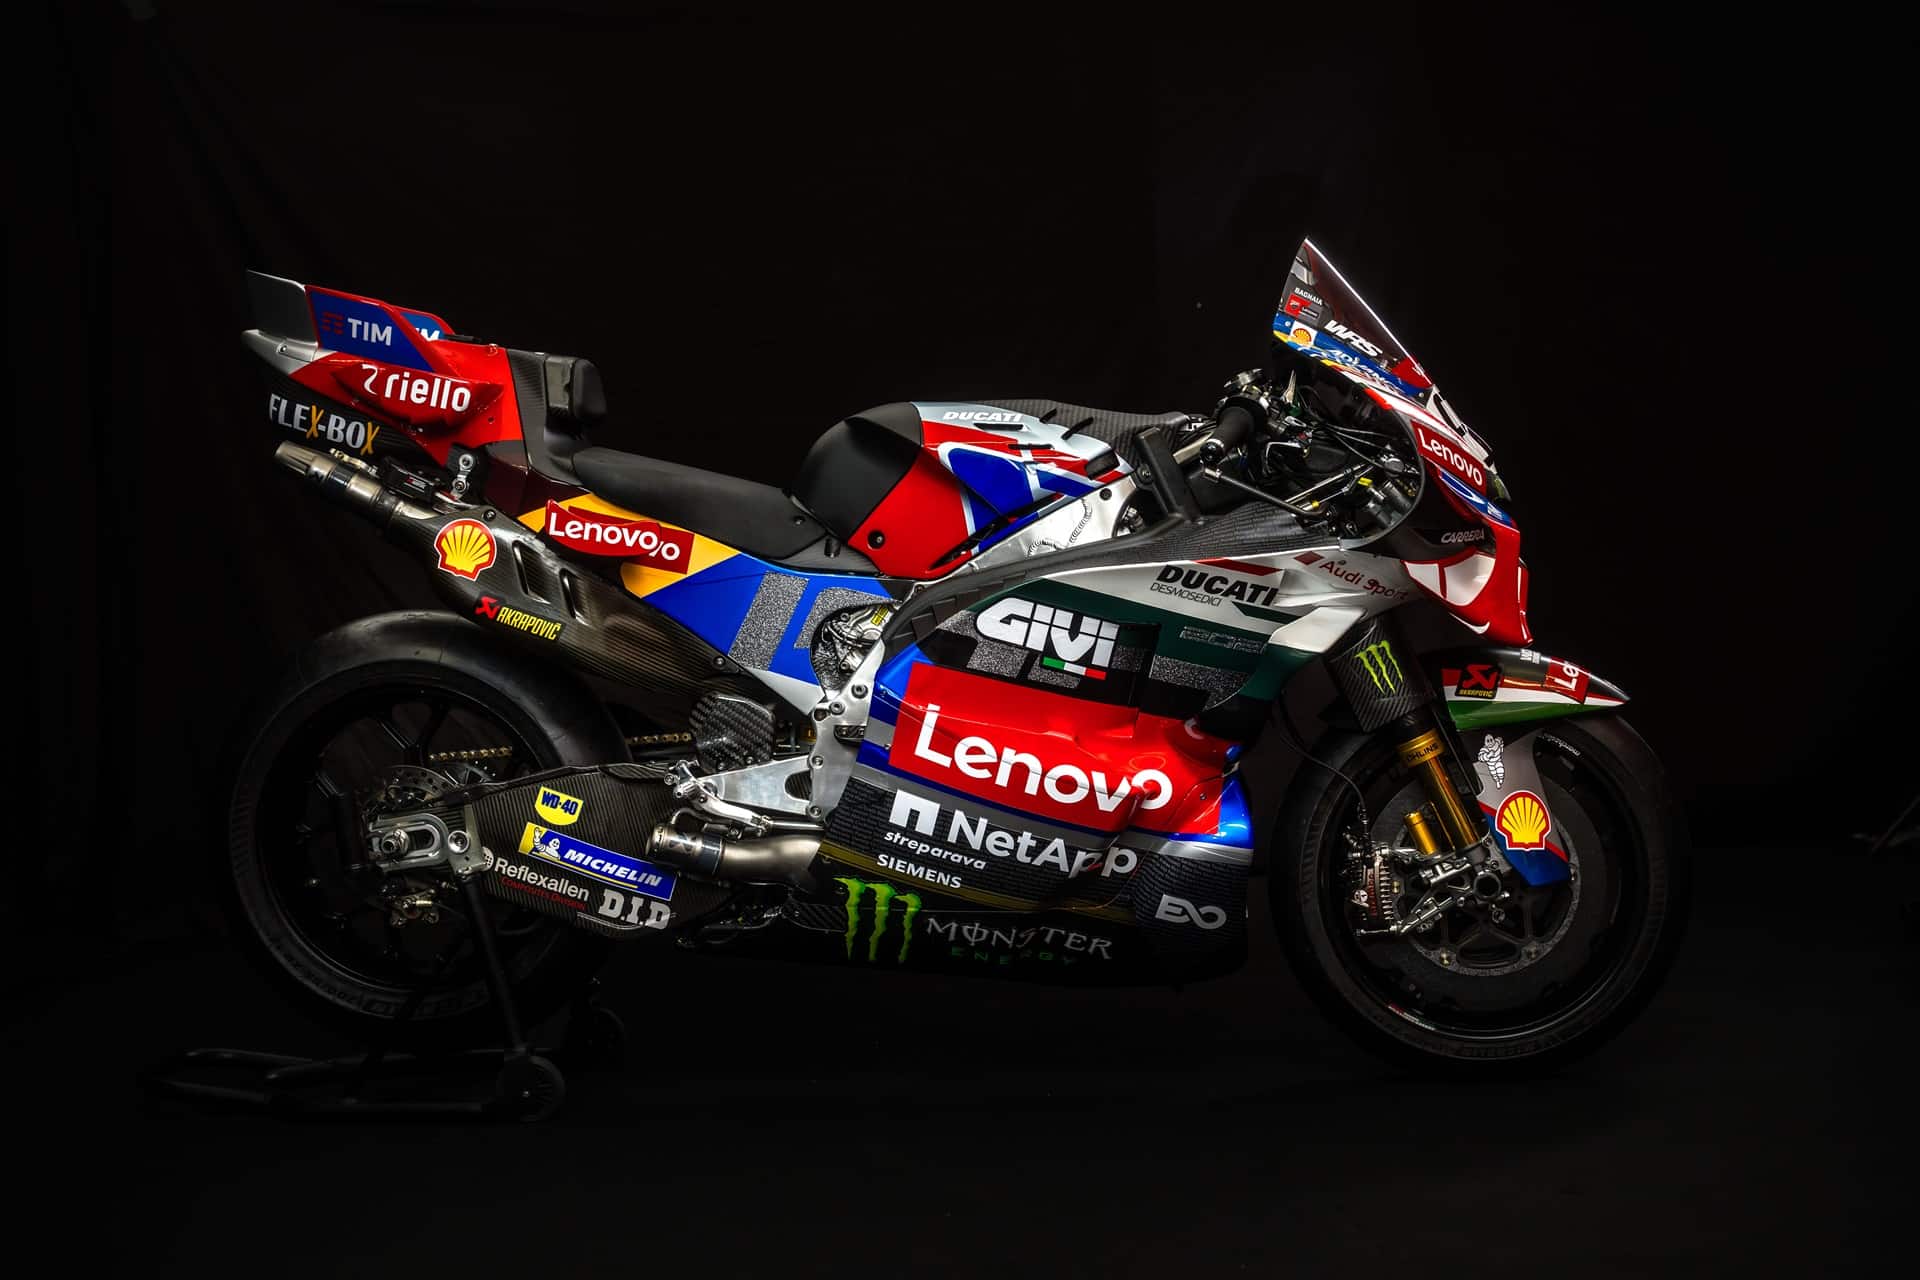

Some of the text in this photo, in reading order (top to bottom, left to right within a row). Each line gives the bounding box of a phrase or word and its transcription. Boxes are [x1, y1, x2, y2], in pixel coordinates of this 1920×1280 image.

[347, 317, 393, 346] TIM
[1324, 319, 1383, 358] WRS
[384, 371, 471, 412] riello
[268, 393, 380, 456] FLEX-BOX
[943, 410, 1023, 423] DUCATI
[1418, 428, 1483, 486] Lenovo
[549, 512, 659, 551] Lenovo
[1441, 527, 1485, 544] CARRERA
[1149, 581, 1223, 607] DESMOSEDICI
[1156, 564, 1282, 607] DUCATI
[1318, 558, 1409, 602] Audi Sport
[976, 597, 1120, 668] GIVI
[914, 703, 1173, 812] Lenovo
[542, 791, 579, 815] WD-40
[884, 831, 987, 870] streparava
[947, 809, 1138, 879] NetApp
[494, 857, 590, 902] Reflexallen
[563, 848, 663, 888] MICHELIN
[876, 853, 962, 889] SIEMENS
[926, 917, 1112, 961] MONSTER
